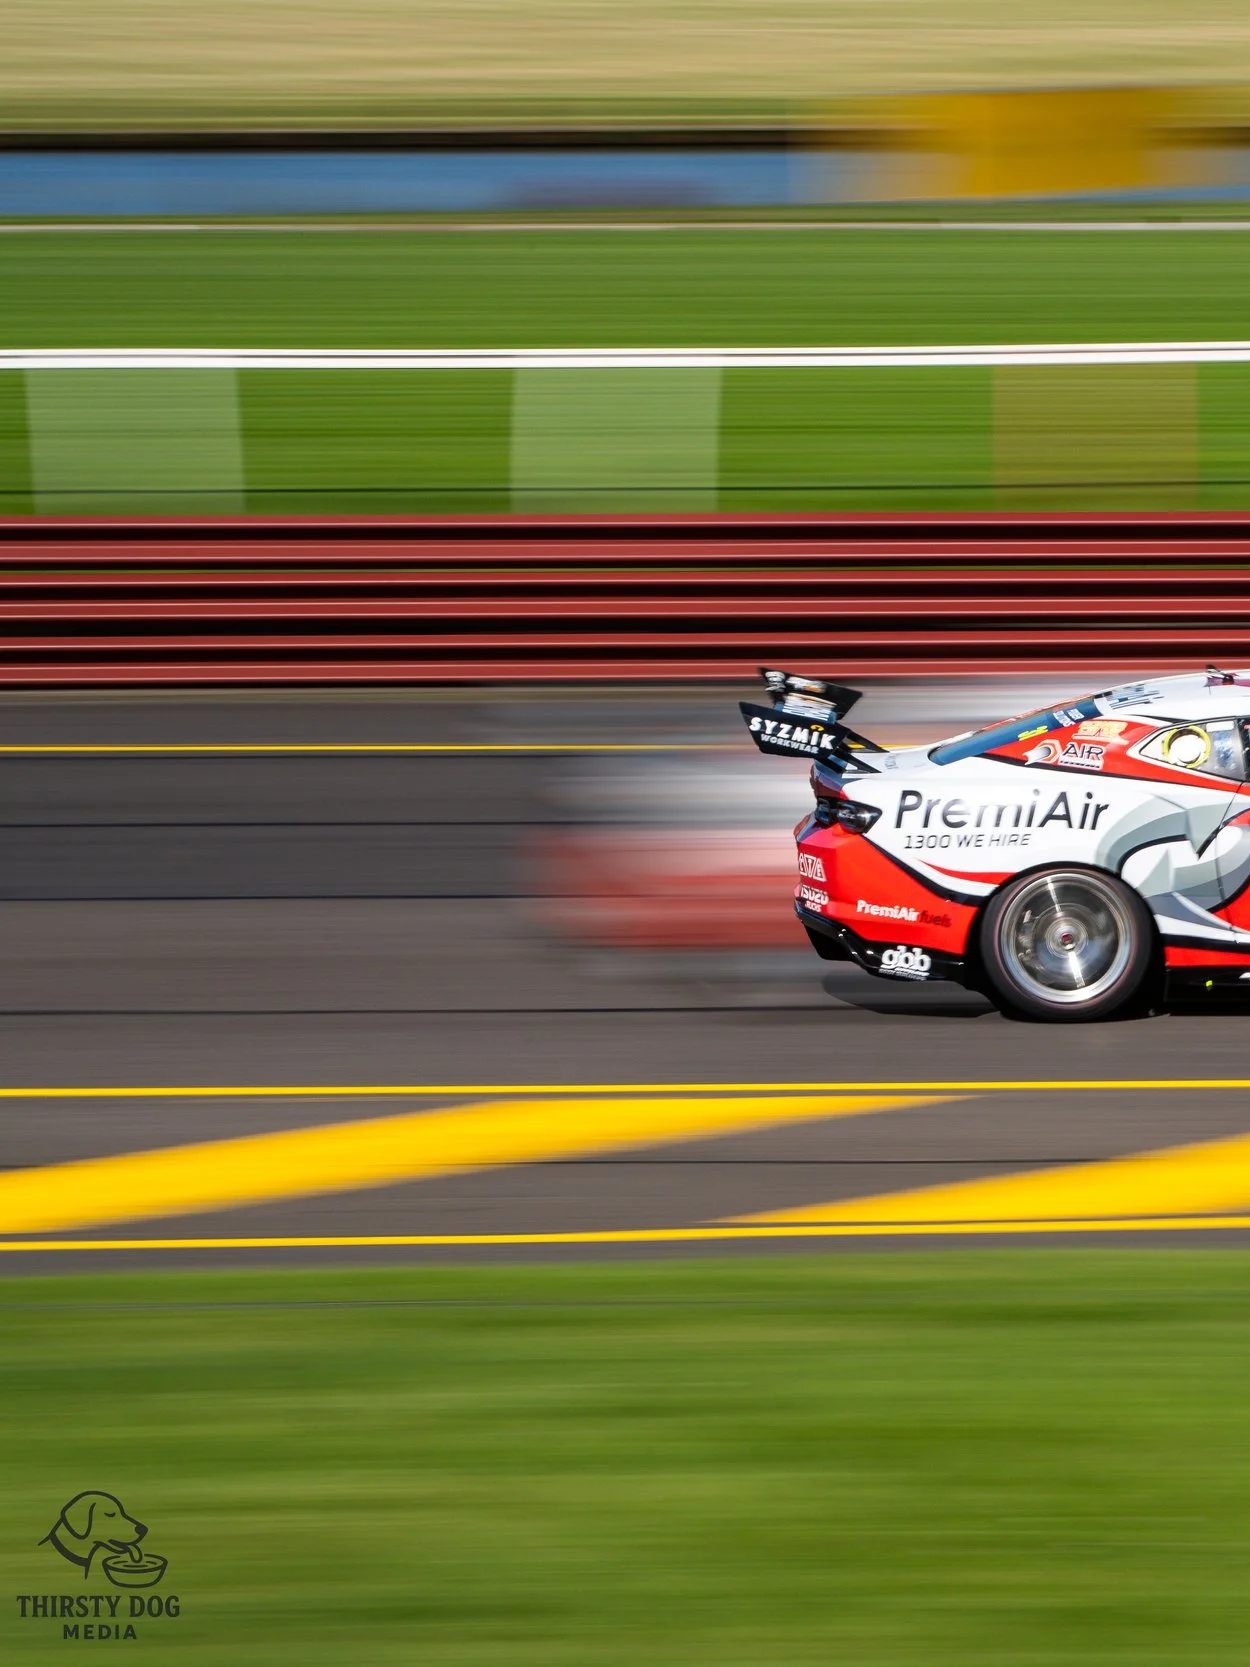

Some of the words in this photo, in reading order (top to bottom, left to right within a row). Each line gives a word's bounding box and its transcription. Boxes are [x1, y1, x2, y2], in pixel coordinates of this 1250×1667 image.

[749, 717, 836, 749] SYZMIK
[761, 733, 820, 754] WORKWEAR
[1062, 743, 1104, 761] AIR
[895, 789, 1110, 830] PremiAir
[904, 834, 951, 849] 1300
[956, 834, 985, 848] WE
[988, 833, 1032, 847] HIRE
[856, 899, 919, 922] PremiAir
[919, 910, 951, 927] fuels
